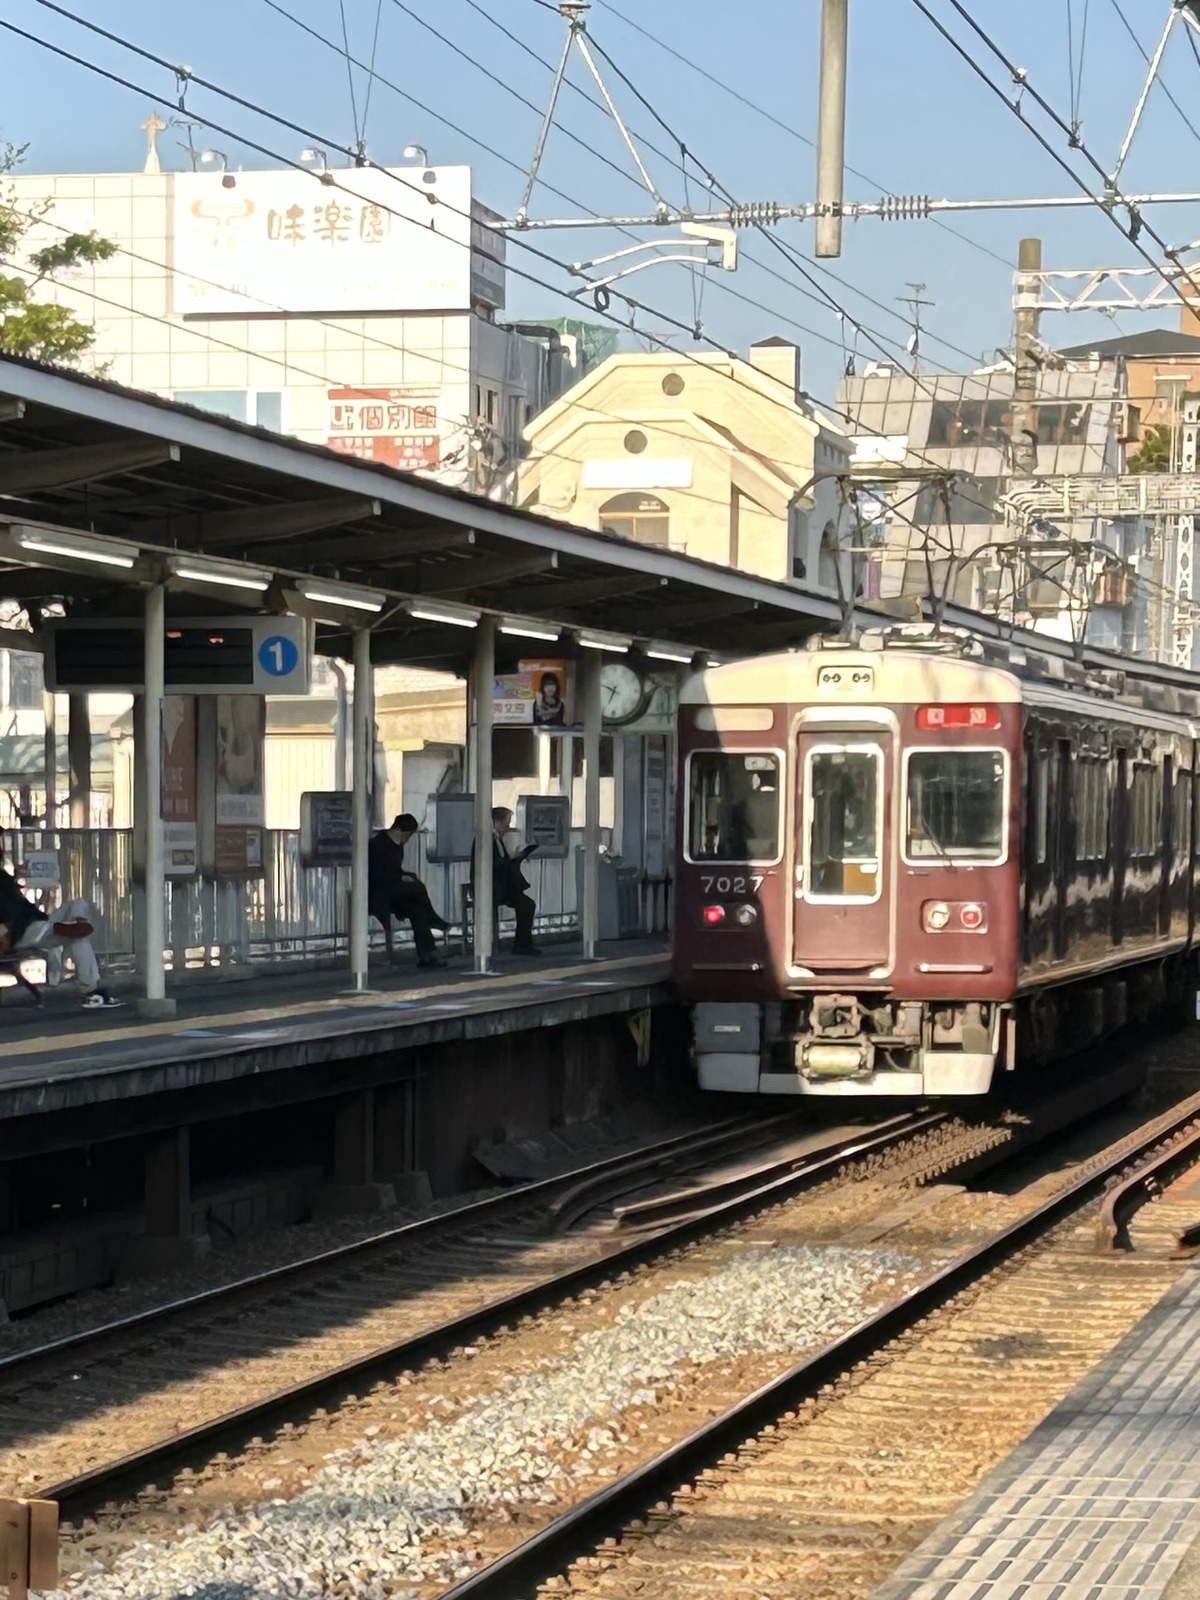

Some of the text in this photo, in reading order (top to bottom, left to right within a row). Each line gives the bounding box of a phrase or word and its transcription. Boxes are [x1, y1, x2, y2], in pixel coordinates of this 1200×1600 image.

[267, 197, 391, 248] 味楽園
[269, 641, 284, 672] 1
[700, 875, 765, 894] 7027
